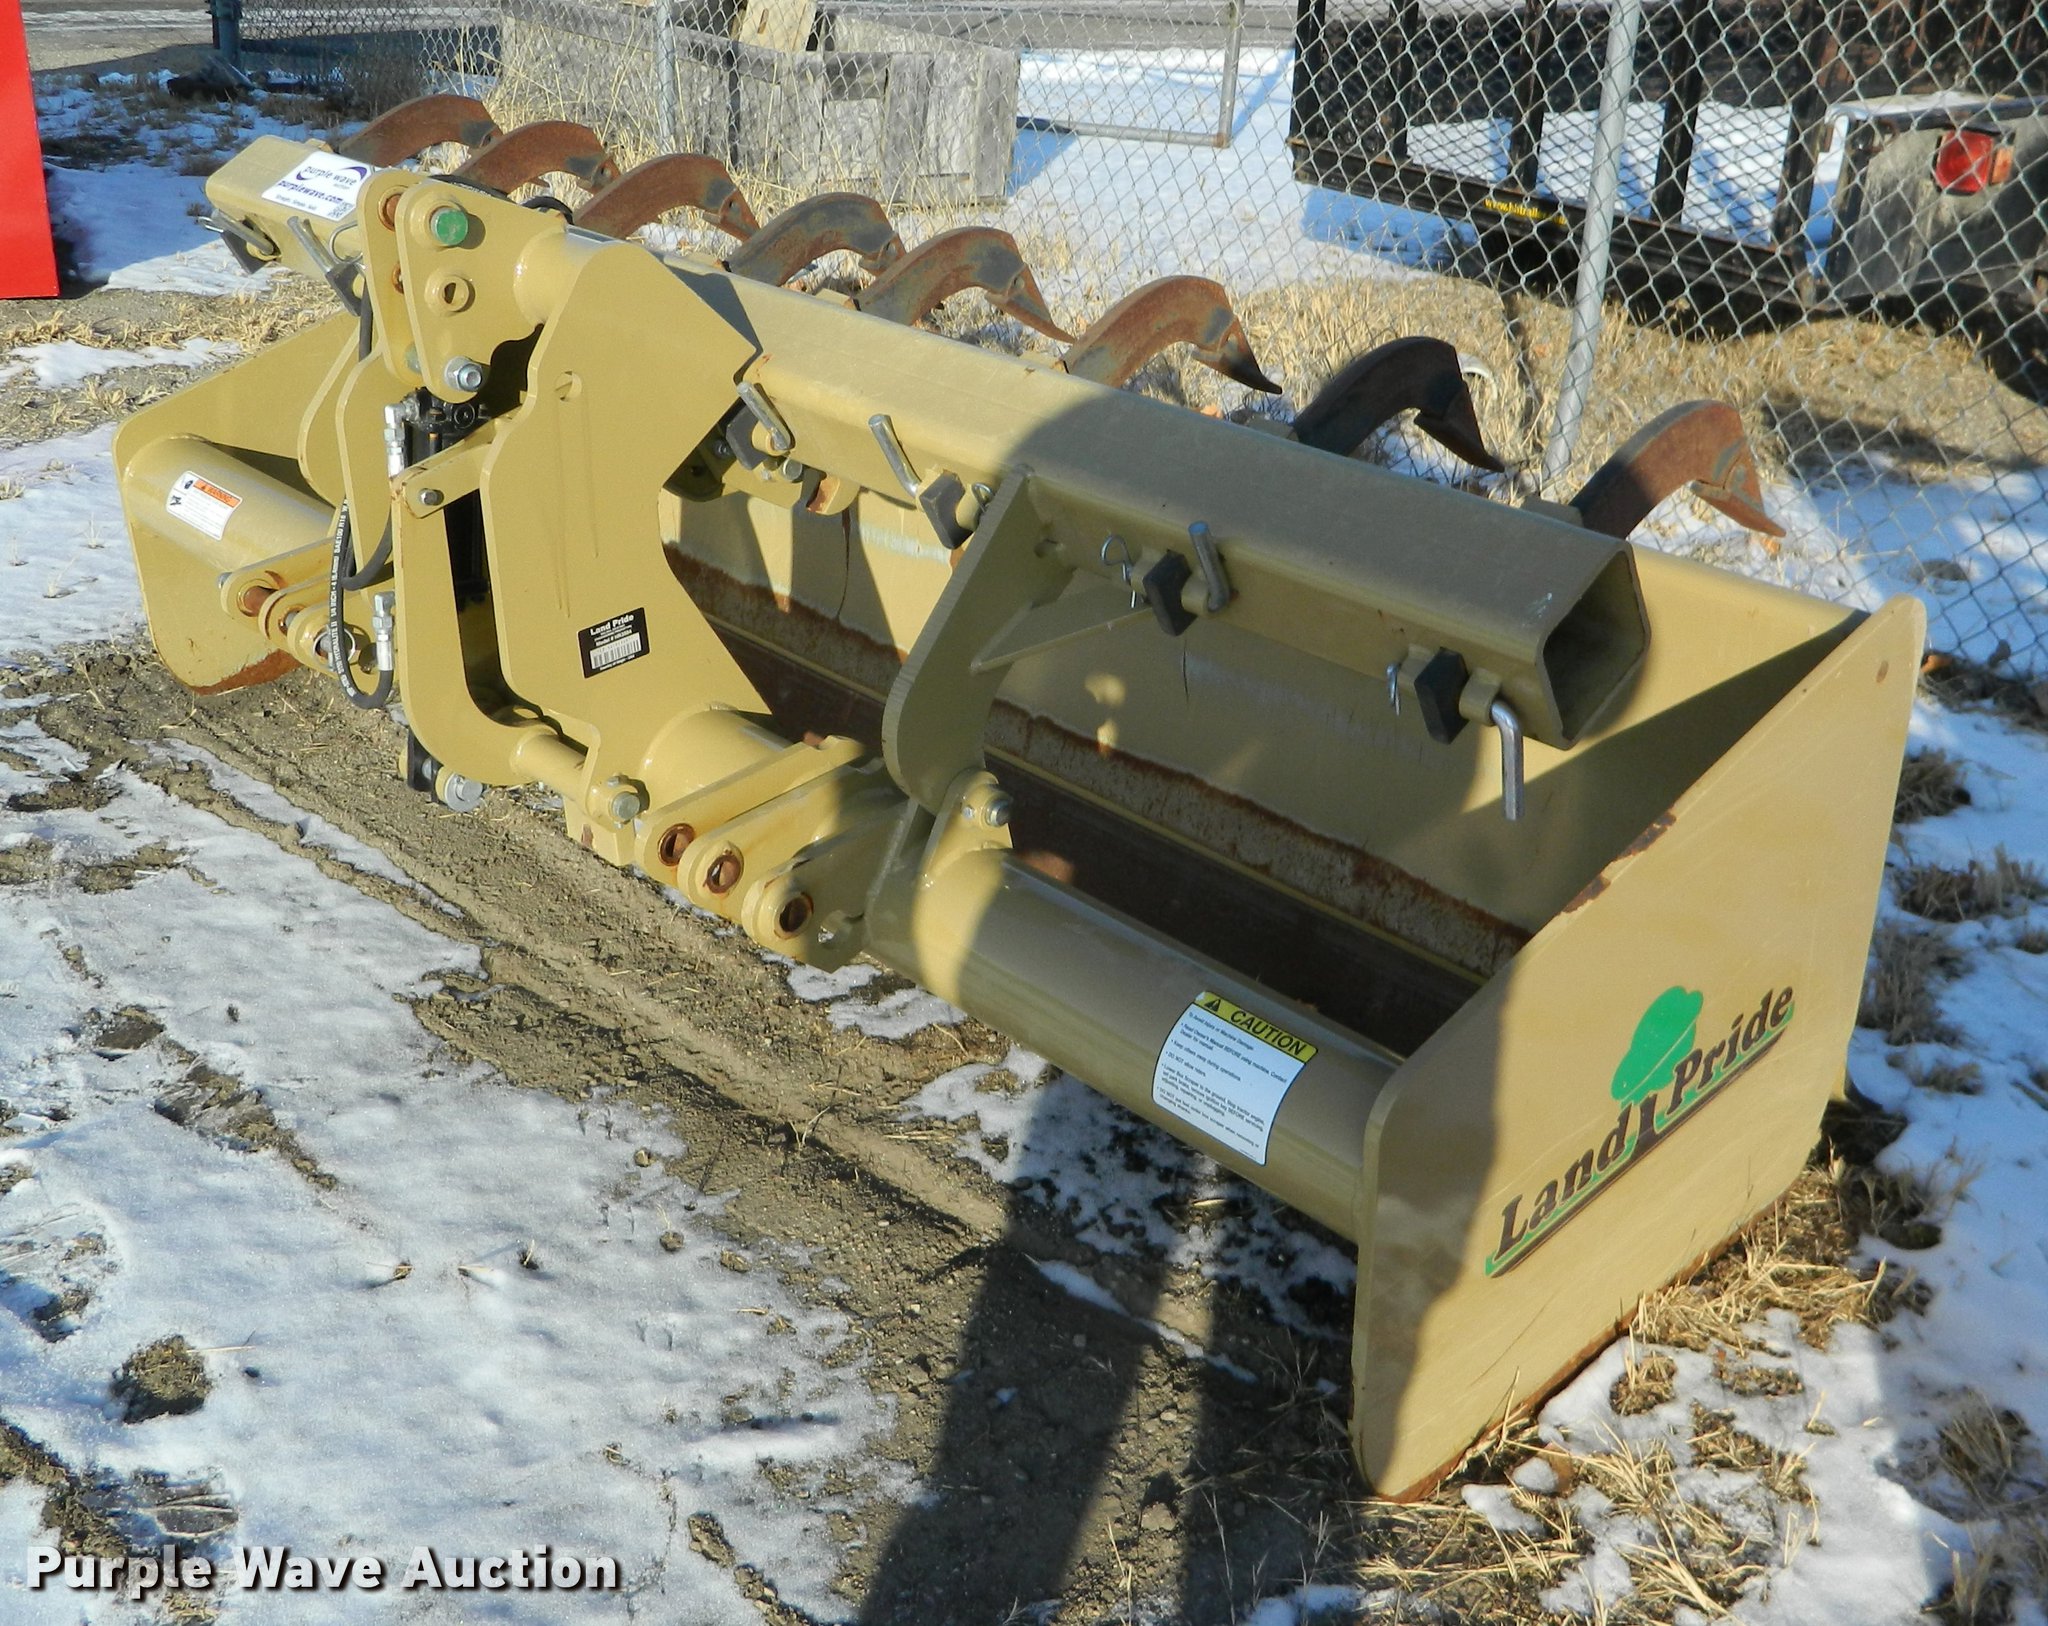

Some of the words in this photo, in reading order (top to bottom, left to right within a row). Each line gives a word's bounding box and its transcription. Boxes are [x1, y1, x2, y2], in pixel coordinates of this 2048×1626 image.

[303, 165, 333, 179] purple
[333, 173, 357, 186] wave
[277, 180, 343, 204] purplewave.com
[590, 622, 611, 635] Land
[612, 614, 634, 627] Pride
[1231, 1010, 1306, 1056] CAUTION
[1493, 1101, 1633, 1262] Land
[1665, 986, 1793, 1116] Pride
